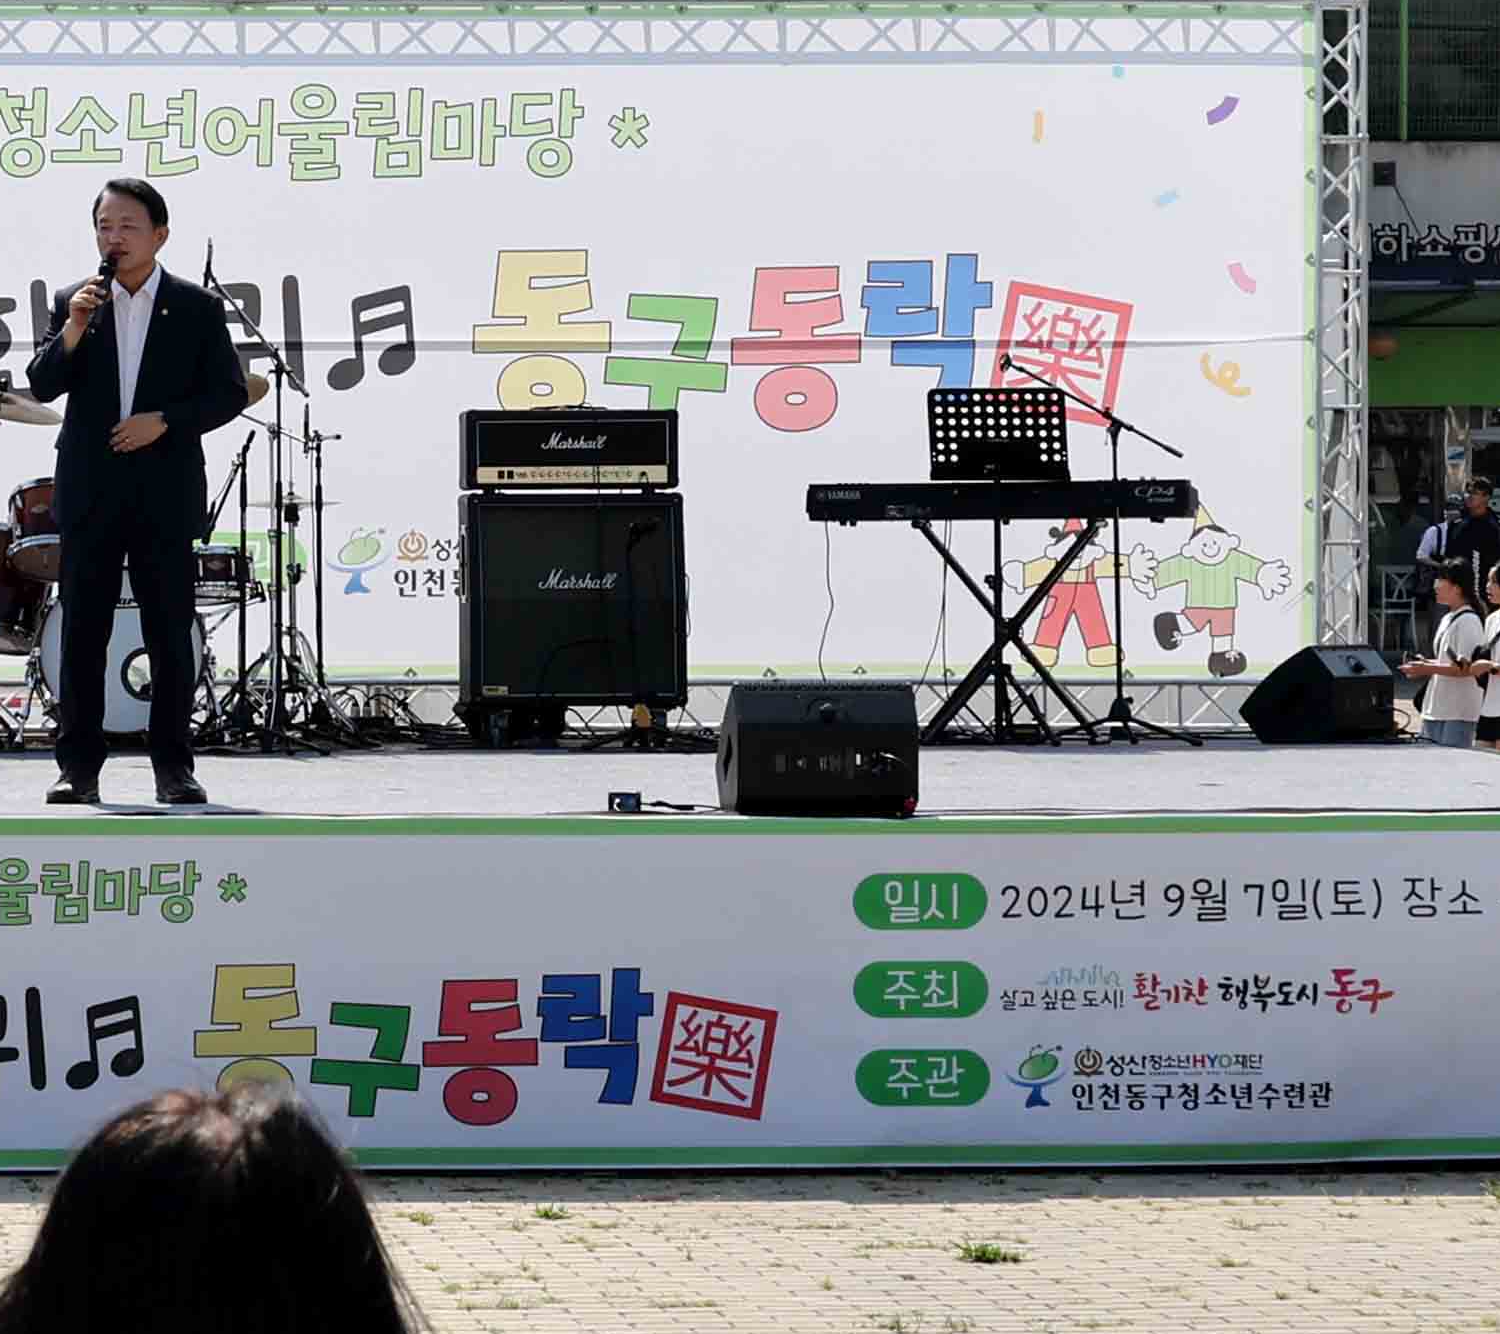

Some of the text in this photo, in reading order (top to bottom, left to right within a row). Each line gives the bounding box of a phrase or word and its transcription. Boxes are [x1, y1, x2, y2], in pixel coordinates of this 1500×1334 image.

[471, 249, 993, 433] 동구동락
[540, 431, 607, 450] Marshall
[538, 568, 617, 590] Marshall
[883, 879, 960, 924] 일시
[1000, 878, 1147, 921] 2024년
[1163, 877, 1228, 922] 9월
[1243, 876, 1384, 921] 7일(토)
[1402, 876, 1484, 918] 장소
[883, 969, 960, 1011] 주최
[1000, 967, 1395, 1014] 살고 싶은 도시! 활기찬 행복도시 동구
[193, 963, 654, 1126] 동구동락
[665, 1009, 758, 1103] 樂
[885, 1057, 965, 1101] 주관
[1072, 1082, 1334, 1111] 인천동구청소년수련관
